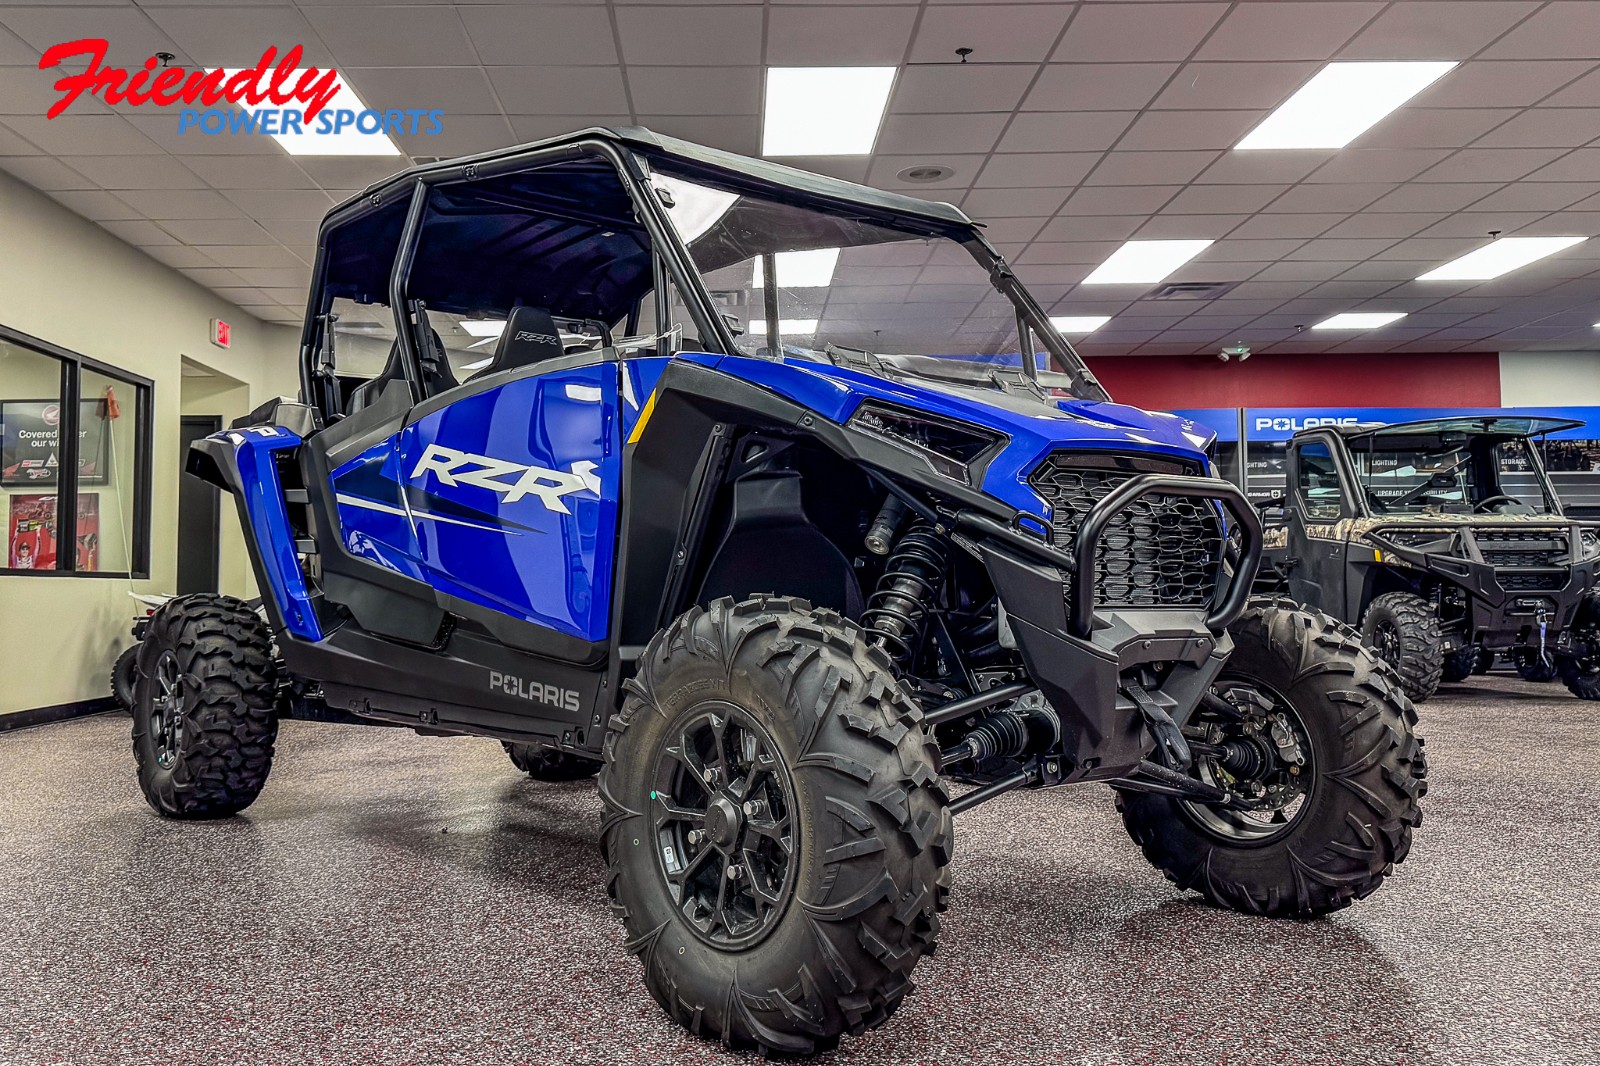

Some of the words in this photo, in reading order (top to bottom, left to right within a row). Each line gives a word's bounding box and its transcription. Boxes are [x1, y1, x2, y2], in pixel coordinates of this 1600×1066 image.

[515, 330, 557, 346] RZR
[19, 429, 58, 439] Covered
[410, 443, 589, 516] RZR
[489, 670, 580, 712] POLARIS
